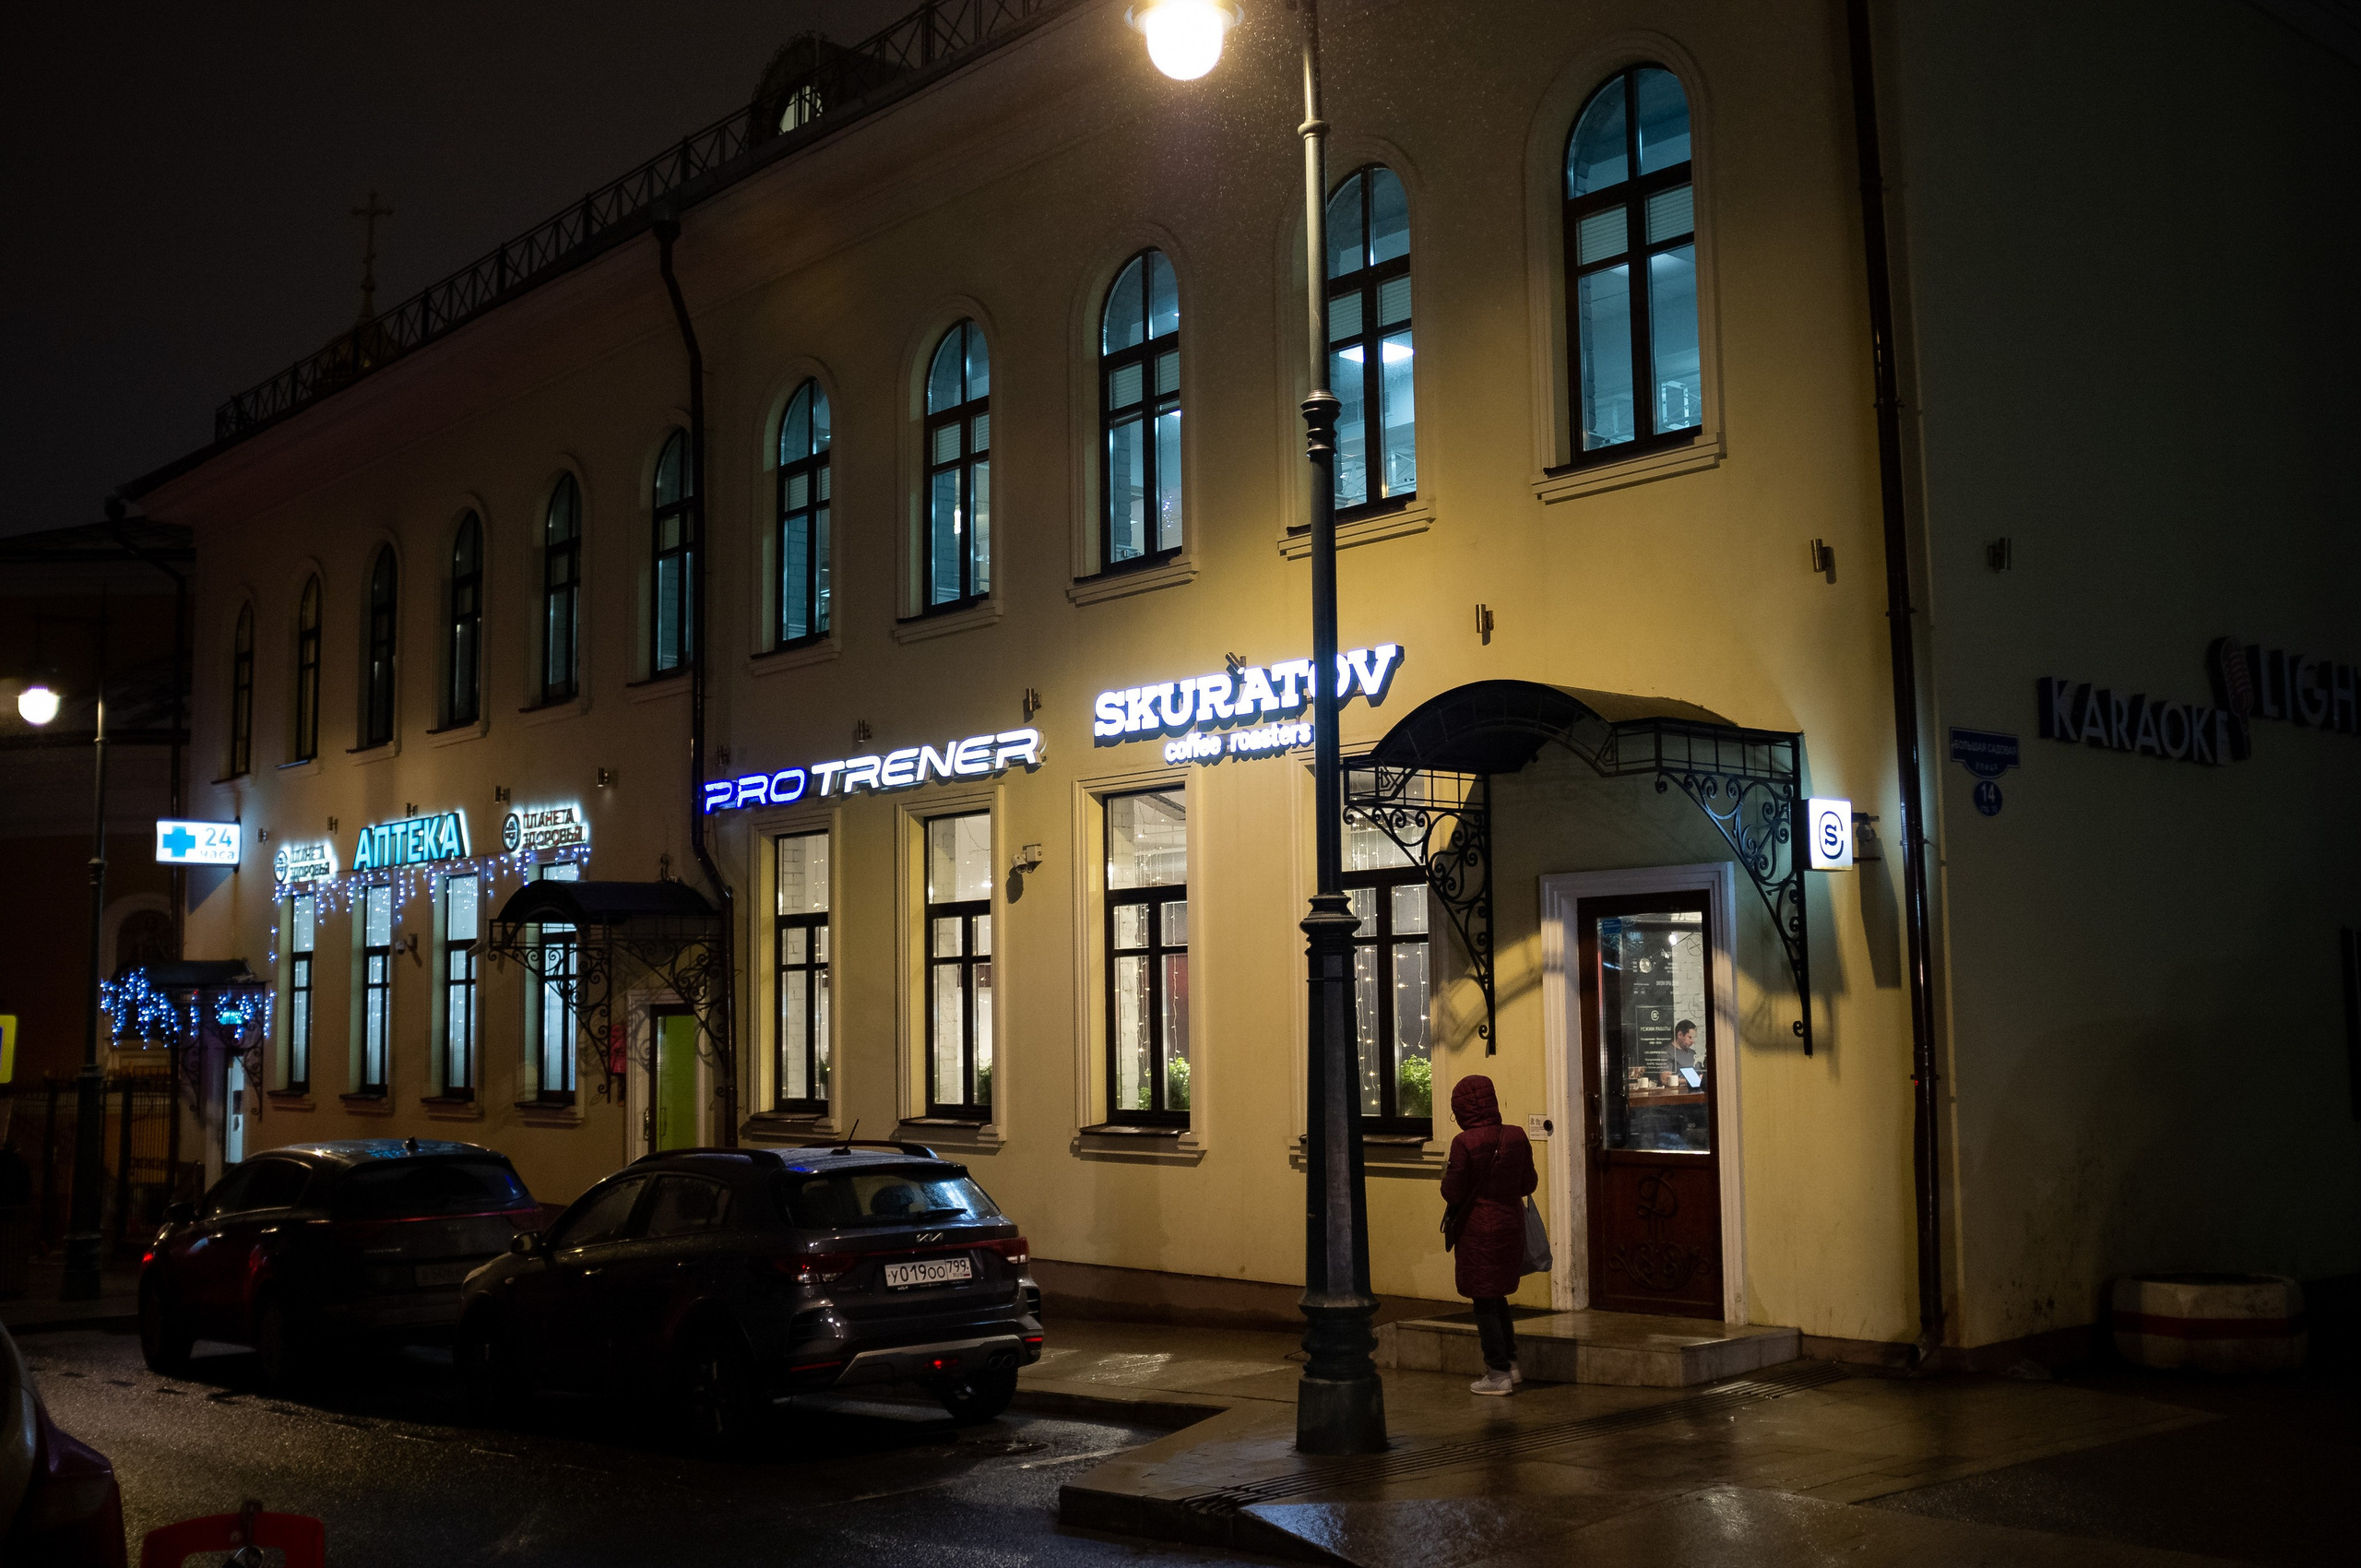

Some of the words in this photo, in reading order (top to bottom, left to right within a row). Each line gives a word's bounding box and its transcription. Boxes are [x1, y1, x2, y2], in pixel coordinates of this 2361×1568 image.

[2259, 645, 2361, 736] LIGH
[1164, 731, 1222, 762] coffee
[1229, 722, 1312, 752] roasters
[1954, 740, 1987, 752] БОЛЬШАЯ
[705, 767, 806, 814] PRO
[811, 727, 1038, 797] TRENER
[1980, 783, 1996, 803] 14
[205, 827, 232, 847] 24
[353, 814, 460, 870] АПТЕКА
[200, 850, 235, 860] часа
[946, 1260, 967, 1273] 799
